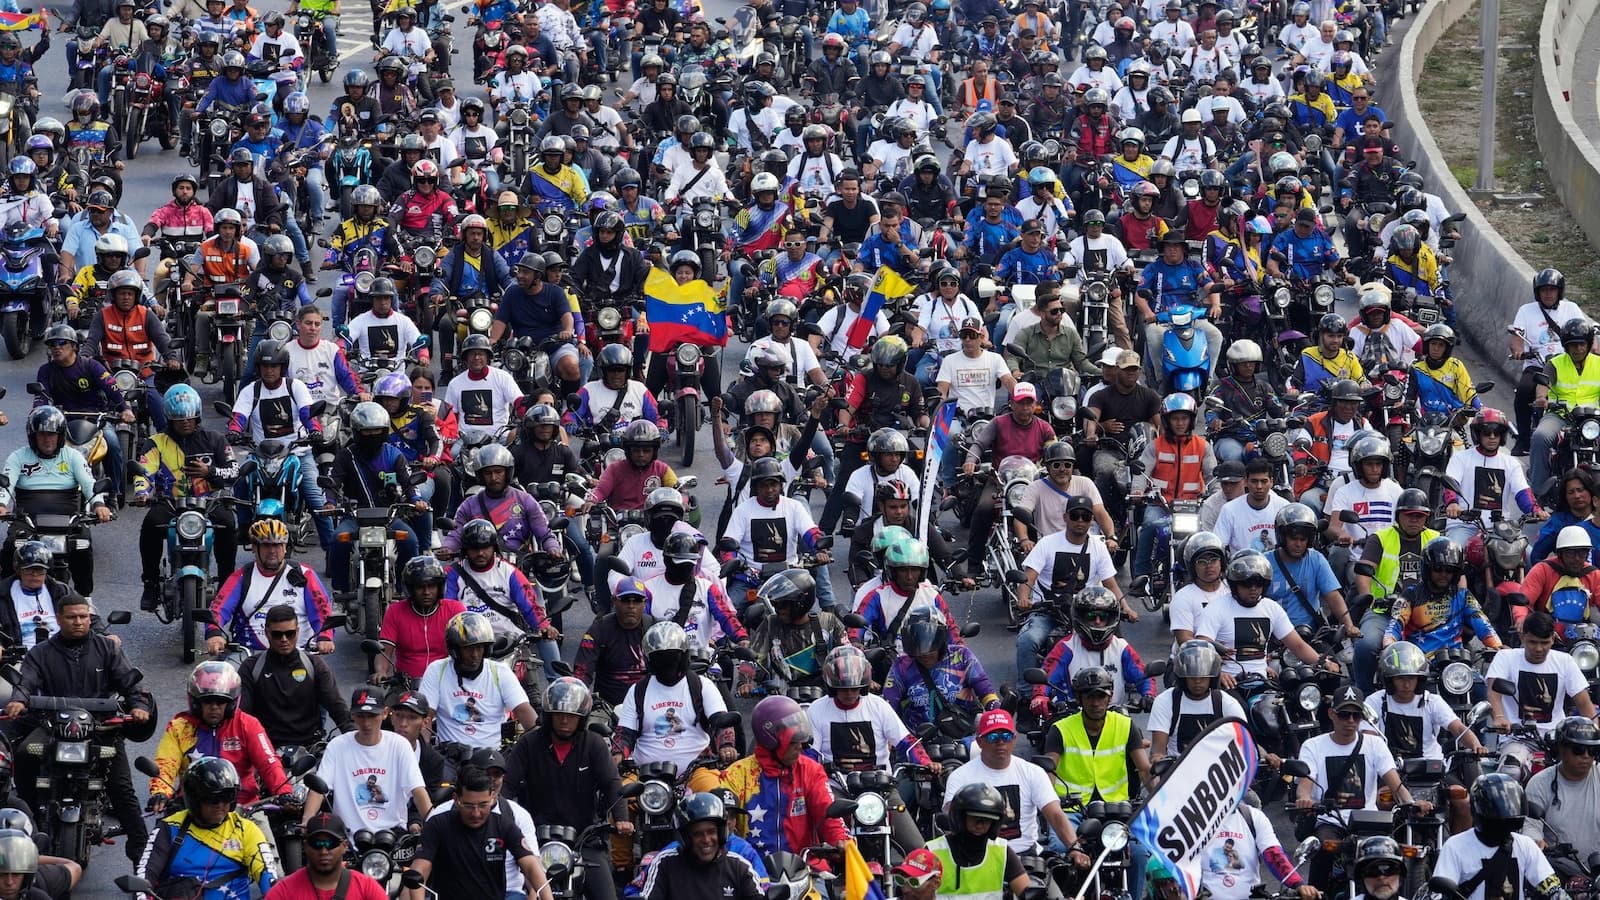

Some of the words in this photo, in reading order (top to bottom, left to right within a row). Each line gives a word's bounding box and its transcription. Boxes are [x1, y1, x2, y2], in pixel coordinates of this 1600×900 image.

[453, 689, 484, 700] LIBERTAD
[651, 701, 684, 711] LIBERTAD
[352, 767, 386, 777] LIBERTAD
[1157, 739, 1247, 863] SINBOM
